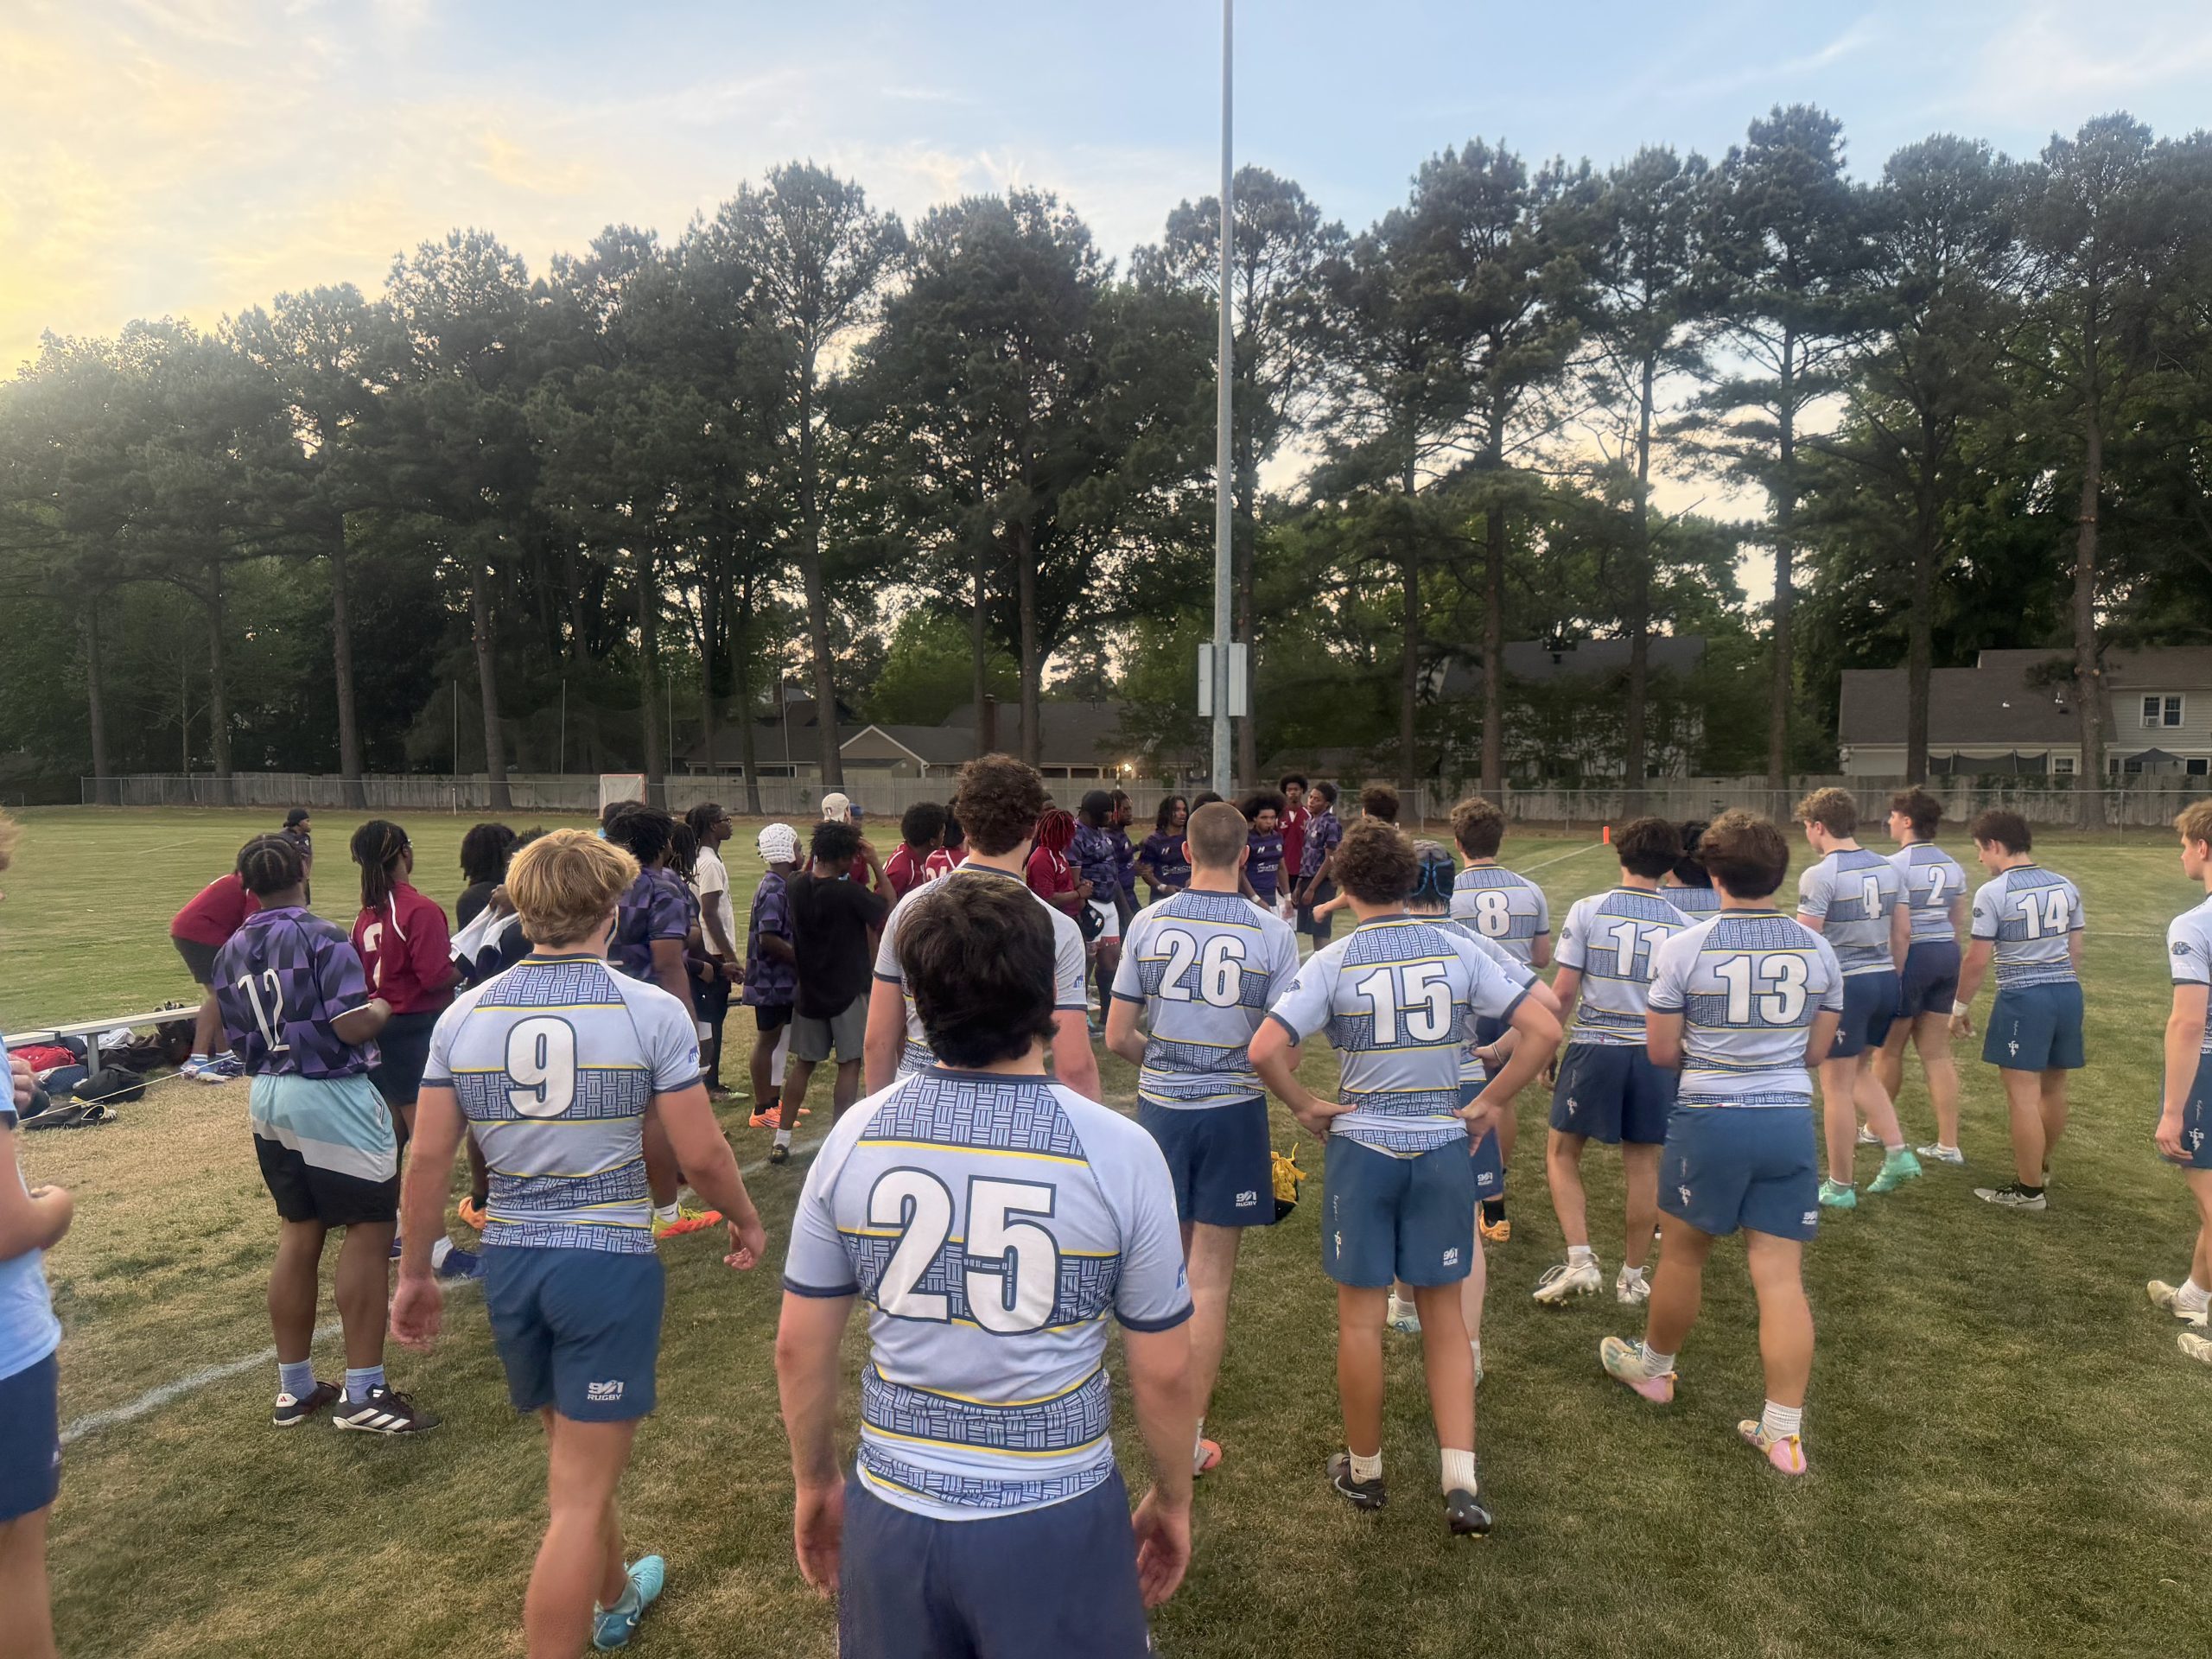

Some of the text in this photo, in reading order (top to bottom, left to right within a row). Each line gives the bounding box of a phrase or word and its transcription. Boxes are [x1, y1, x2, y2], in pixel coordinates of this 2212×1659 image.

[1474, 890, 1511, 939] 8
[1862, 874, 1883, 920] 4
[1926, 865, 1946, 906] 2
[2016, 887, 2070, 940] 14
[1154, 928, 1247, 1009] 26
[1608, 920, 1669, 981] 11
[238, 968, 290, 1052] 12
[1355, 961, 1452, 1046] 15
[1713, 952, 1809, 1026] 13
[505, 1014, 578, 1120] 9
[867, 1165, 1057, 1338] 25
